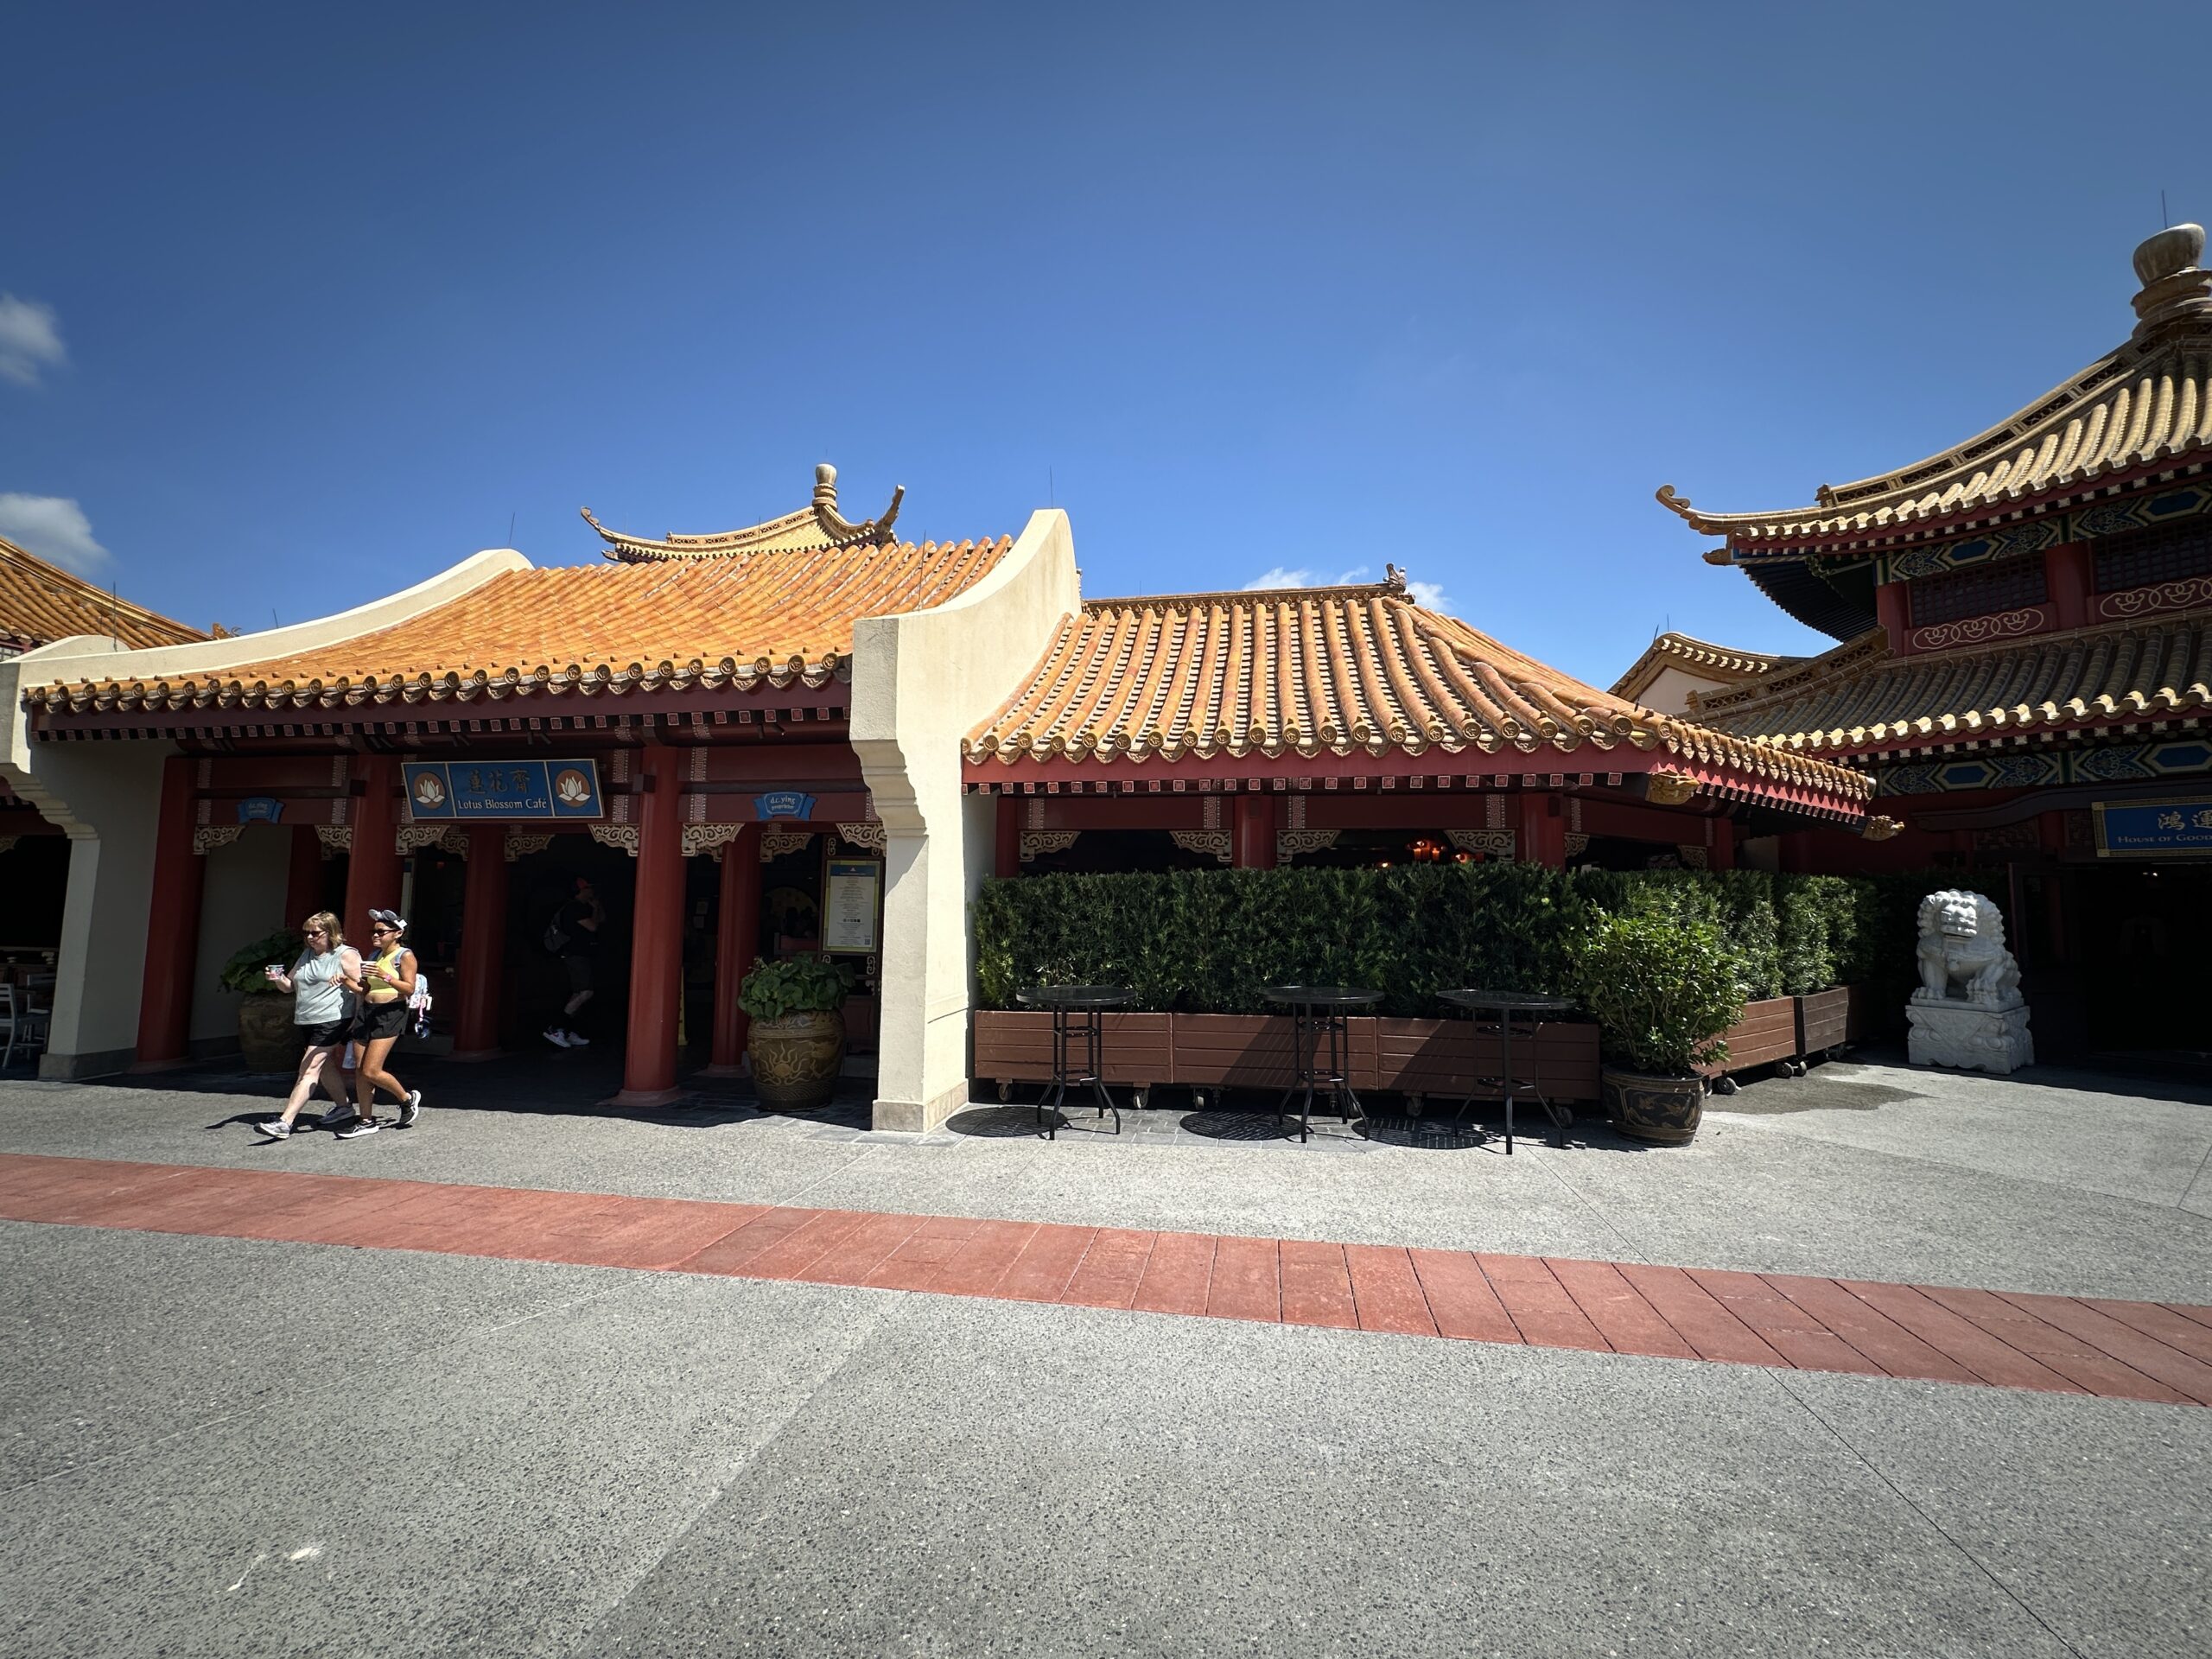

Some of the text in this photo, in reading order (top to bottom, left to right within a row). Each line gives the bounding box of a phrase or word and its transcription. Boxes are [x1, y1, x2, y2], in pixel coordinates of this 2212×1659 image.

[458, 798, 546, 810] Lotus Blossom Café
